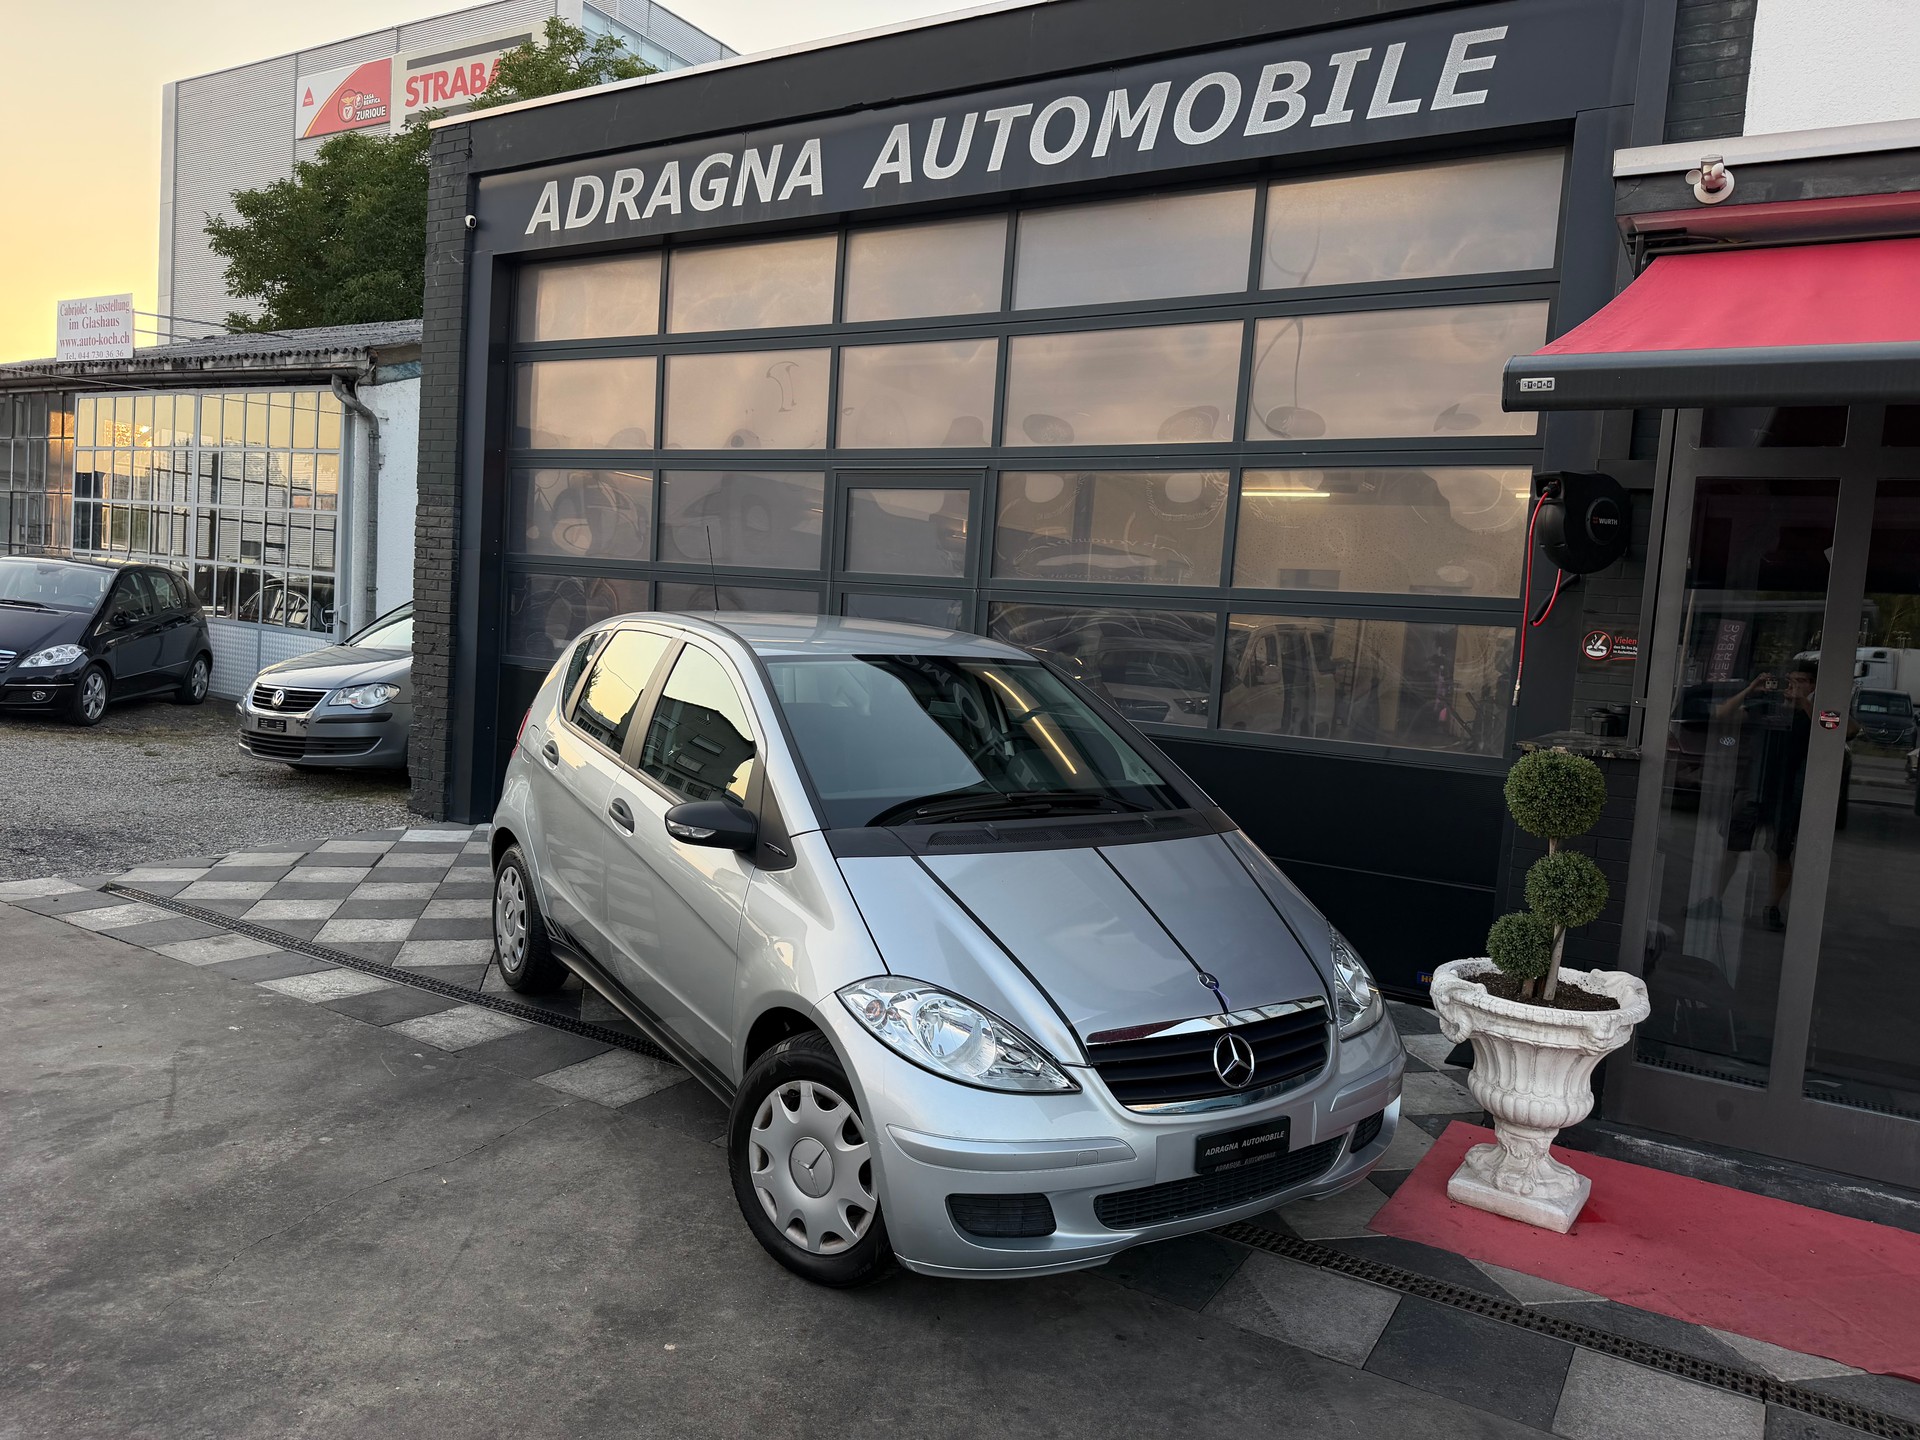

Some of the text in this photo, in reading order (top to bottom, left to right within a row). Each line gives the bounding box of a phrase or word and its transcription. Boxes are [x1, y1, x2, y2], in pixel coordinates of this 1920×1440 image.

[356, 106, 386, 121] ZURIQUE
[525, 25, 1509, 235] ADRAGNA AUTOMOBILE
[60, 303, 87, 317] Cabriolet
[94, 299, 130, 313] Ausstellung
[69, 315, 120, 330] im Glashaus
[59, 331, 130, 348] www.auto-koch.ch
[78, 351, 89, 359] 044
[91, 350, 103, 359] 730
[105, 350, 114, 358] 36
[116, 349, 124, 357] 36
[1522, 380, 1553, 390] STOBAG
[1614, 636, 1637, 645] Vielen
[1205, 1130, 1285, 1157] ADRAGNA AUTOMOBILE
